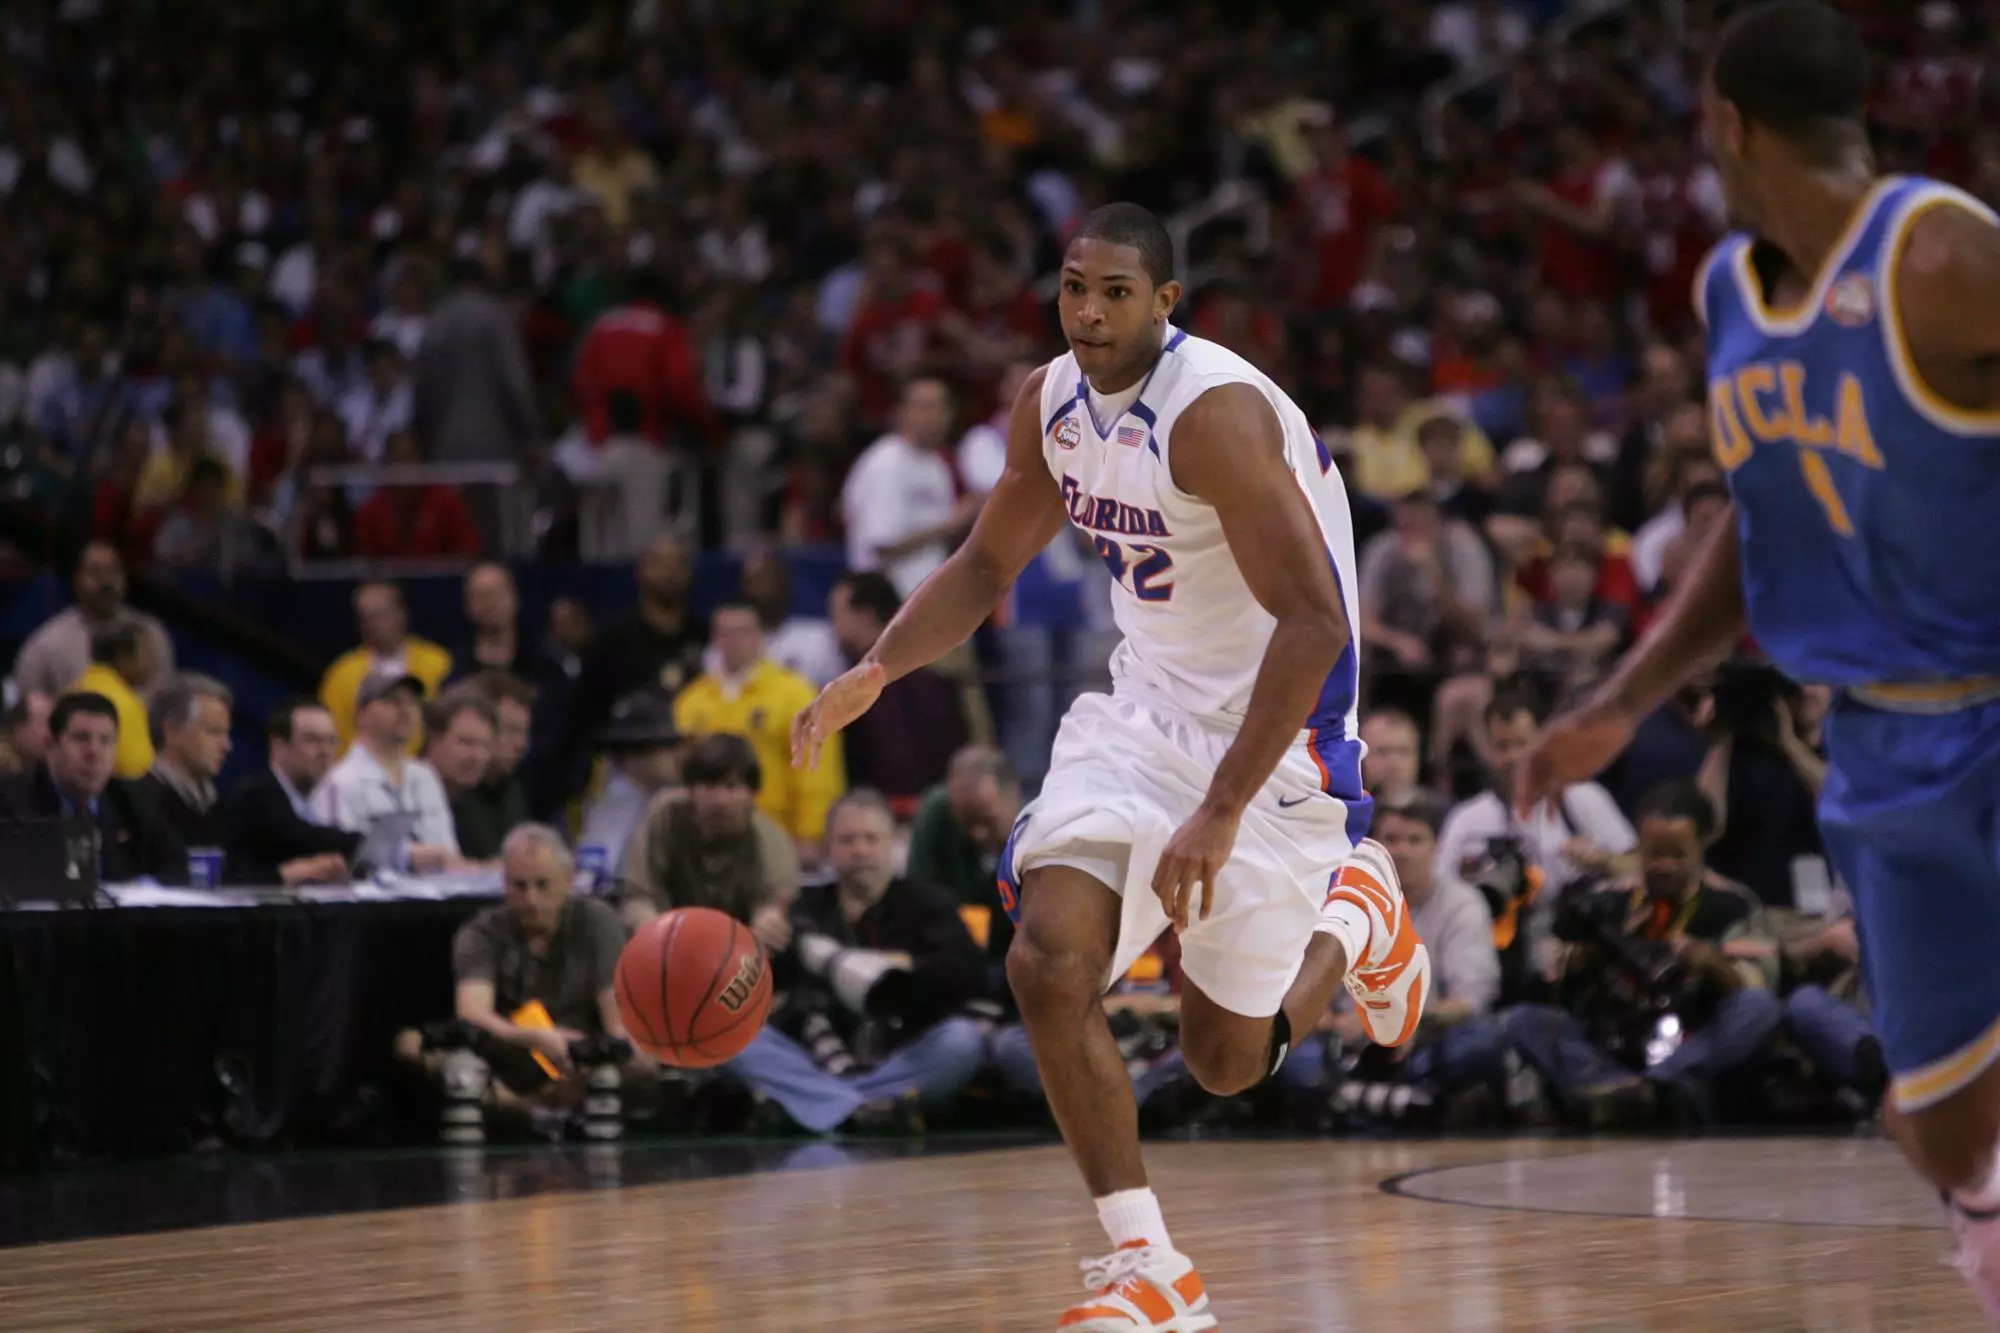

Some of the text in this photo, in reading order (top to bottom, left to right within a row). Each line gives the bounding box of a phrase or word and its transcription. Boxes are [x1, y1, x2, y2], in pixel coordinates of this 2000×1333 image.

[1711, 363, 1885, 470] UCLA
[1061, 472, 1173, 536] FLORIDA
[1801, 449, 1854, 536] 1
[717, 956, 761, 1011] Wil
